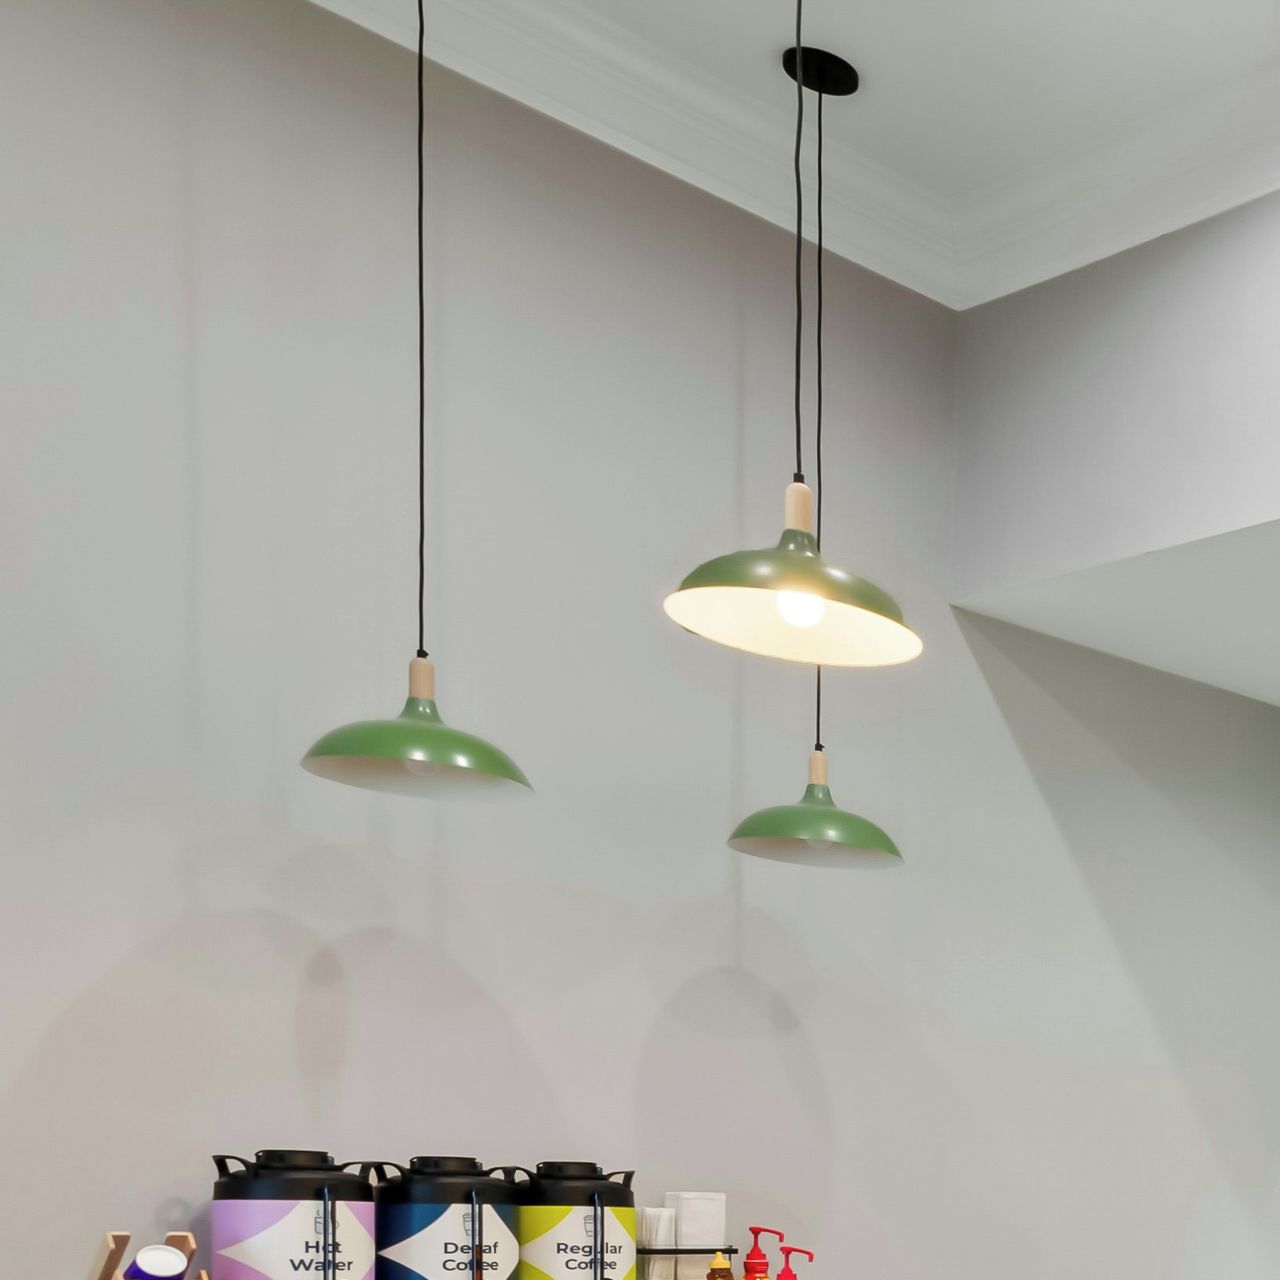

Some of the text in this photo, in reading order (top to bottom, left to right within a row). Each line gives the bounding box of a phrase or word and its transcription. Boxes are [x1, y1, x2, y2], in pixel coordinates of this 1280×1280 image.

[443, 1241, 499, 1254] Deaf
[556, 1242, 623, 1257] Reglar
[442, 1259, 499, 1271] Cofee
